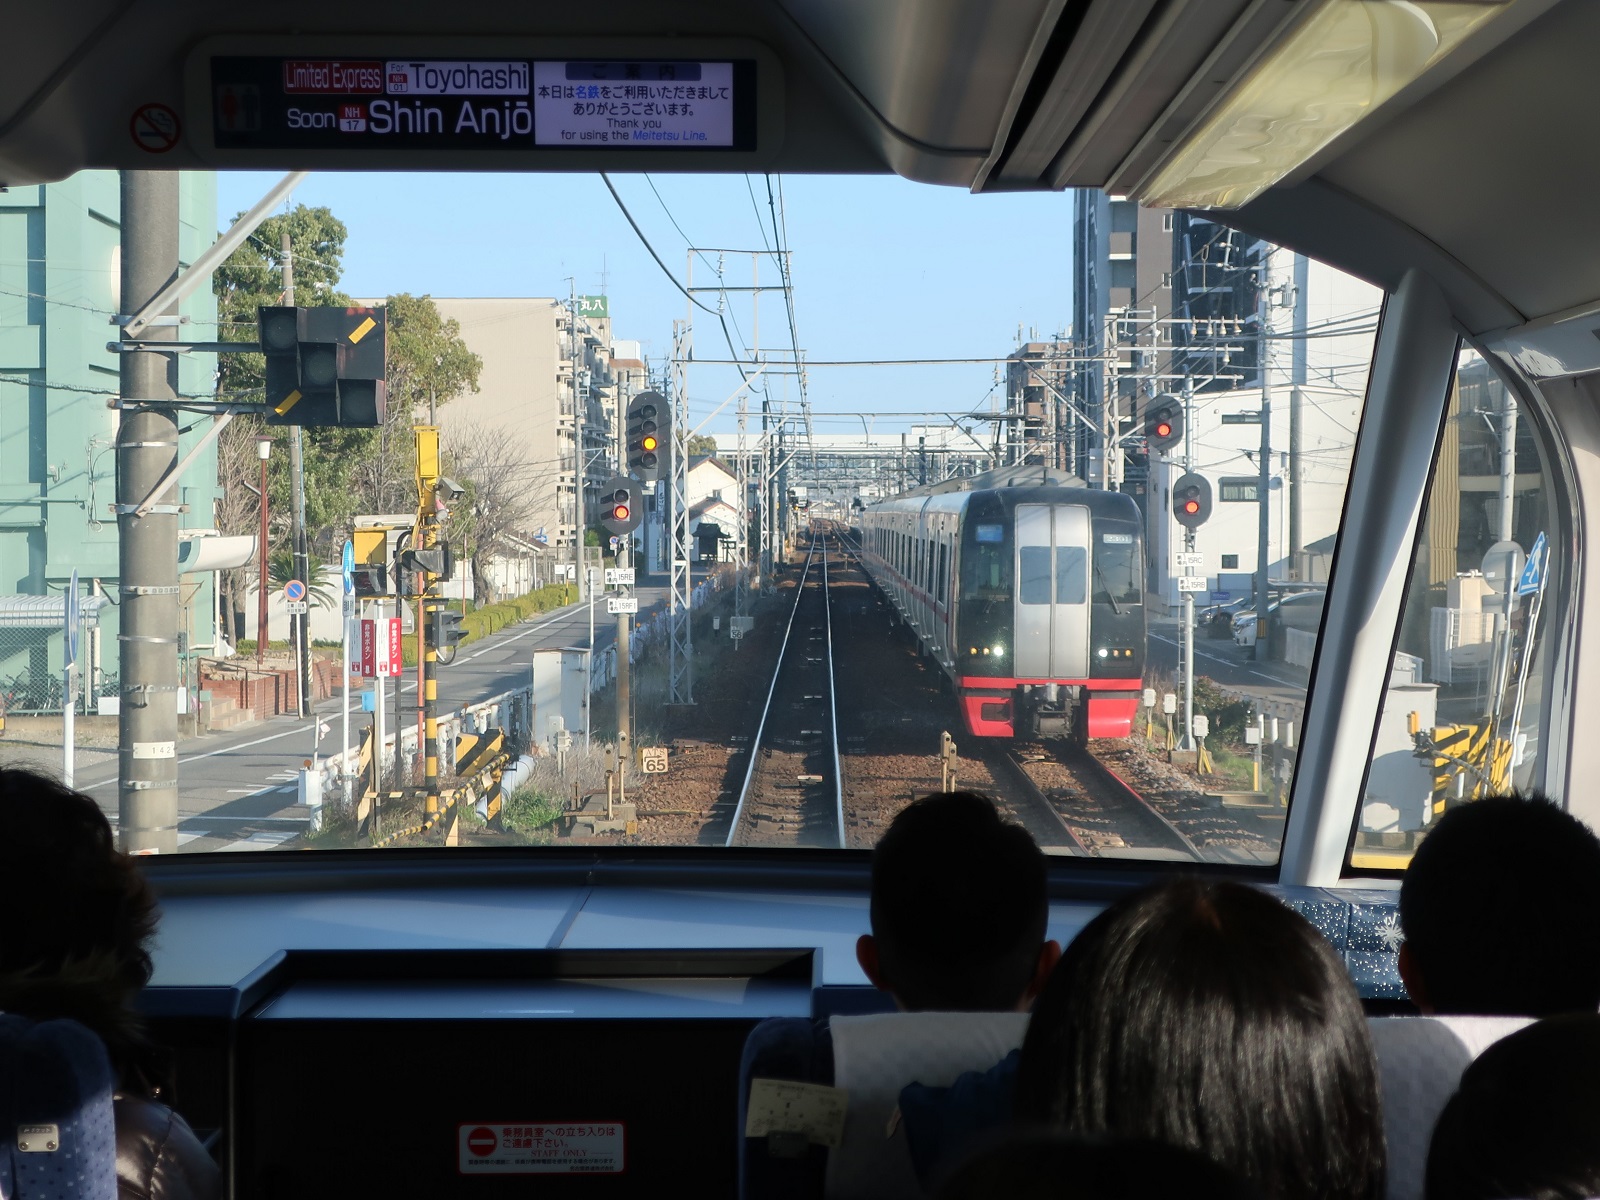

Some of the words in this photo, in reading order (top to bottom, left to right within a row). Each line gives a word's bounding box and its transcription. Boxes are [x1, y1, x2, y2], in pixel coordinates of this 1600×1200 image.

[390, 64, 404, 72] For
[285, 63, 329, 88] Limited
[333, 63, 381, 93] Express
[409, 63, 528, 93] Toyohashi
[538, 85, 729, 100] 本日は名鉄をご利用いただきまして
[344, 107, 360, 118] NH
[573, 102, 694, 116] ありがとうございます。
[287, 108, 335, 128] Soon
[369, 100, 442, 133] Shin
[455, 101, 532, 140] Anjō
[607, 118, 639, 129] Thank
[643, 120, 661, 129] you
[346, 120, 359, 130] 17
[561, 130, 576, 140] for
[580, 131, 608, 142] using
[612, 131, 629, 140] the
[632, 130, 679, 141] Meitetsu
[683, 130, 708, 141] Line.
[580, 299, 604, 311] 丸八
[646, 759, 666, 772] 65
[502, 1127, 616, 1137] 乗務員室への立ち入りは
[502, 1138, 569, 1149] ご遠慮下さい。
